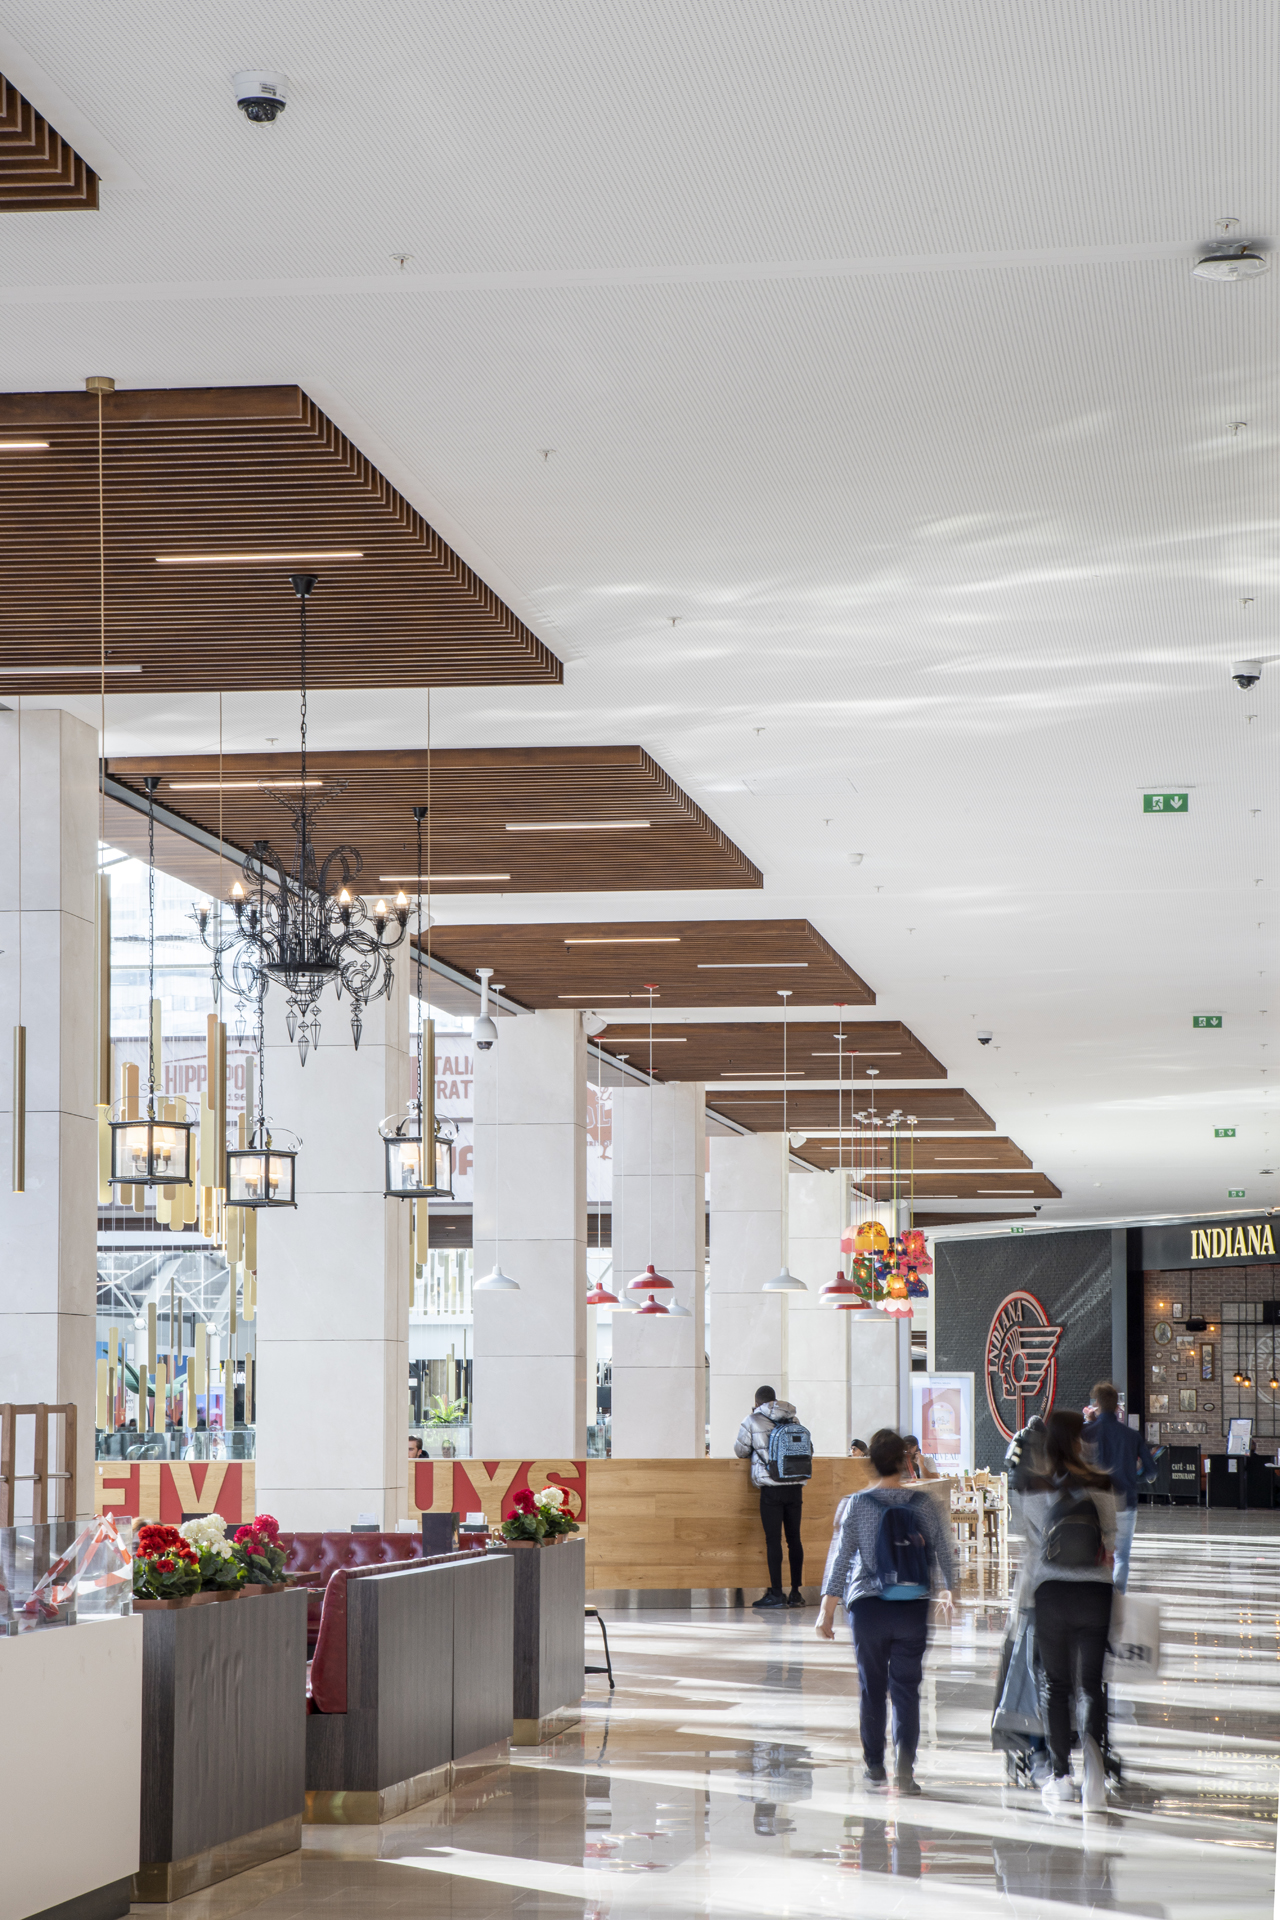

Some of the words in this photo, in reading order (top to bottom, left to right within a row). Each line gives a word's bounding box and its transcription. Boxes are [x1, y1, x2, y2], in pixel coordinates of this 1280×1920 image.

[1191, 1224, 1275, 1259] INDIANA
[989, 1300, 1023, 1372] INDIANA
[1171, 1462, 1183, 1471] CAFÉ
[1186, 1463, 1196, 1471] BAR
[1171, 1472, 1196, 1480] RESTAURANT
